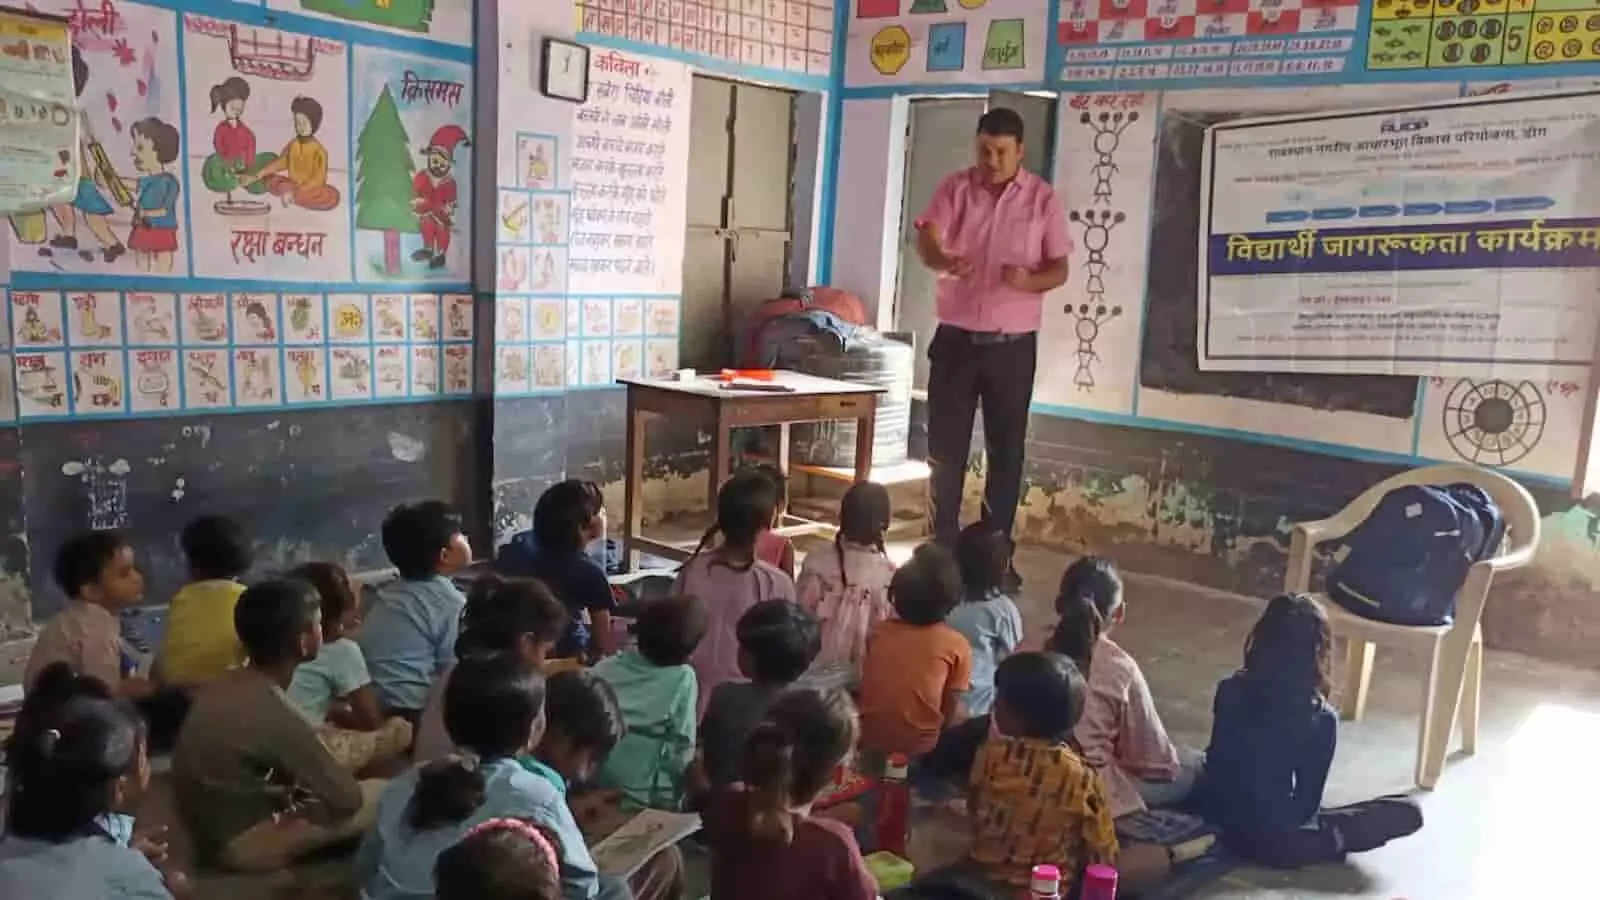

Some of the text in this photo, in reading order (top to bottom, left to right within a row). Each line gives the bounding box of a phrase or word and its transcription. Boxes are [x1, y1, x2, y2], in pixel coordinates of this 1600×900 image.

[1507, 26, 1524, 52] 5
[401, 69, 464, 109] क्रिसमस
[230, 230, 328, 265] रक्षा बन्धन
[1226, 217, 1600, 262] विद्यार्थी जागरूकता कार्यक्रम
